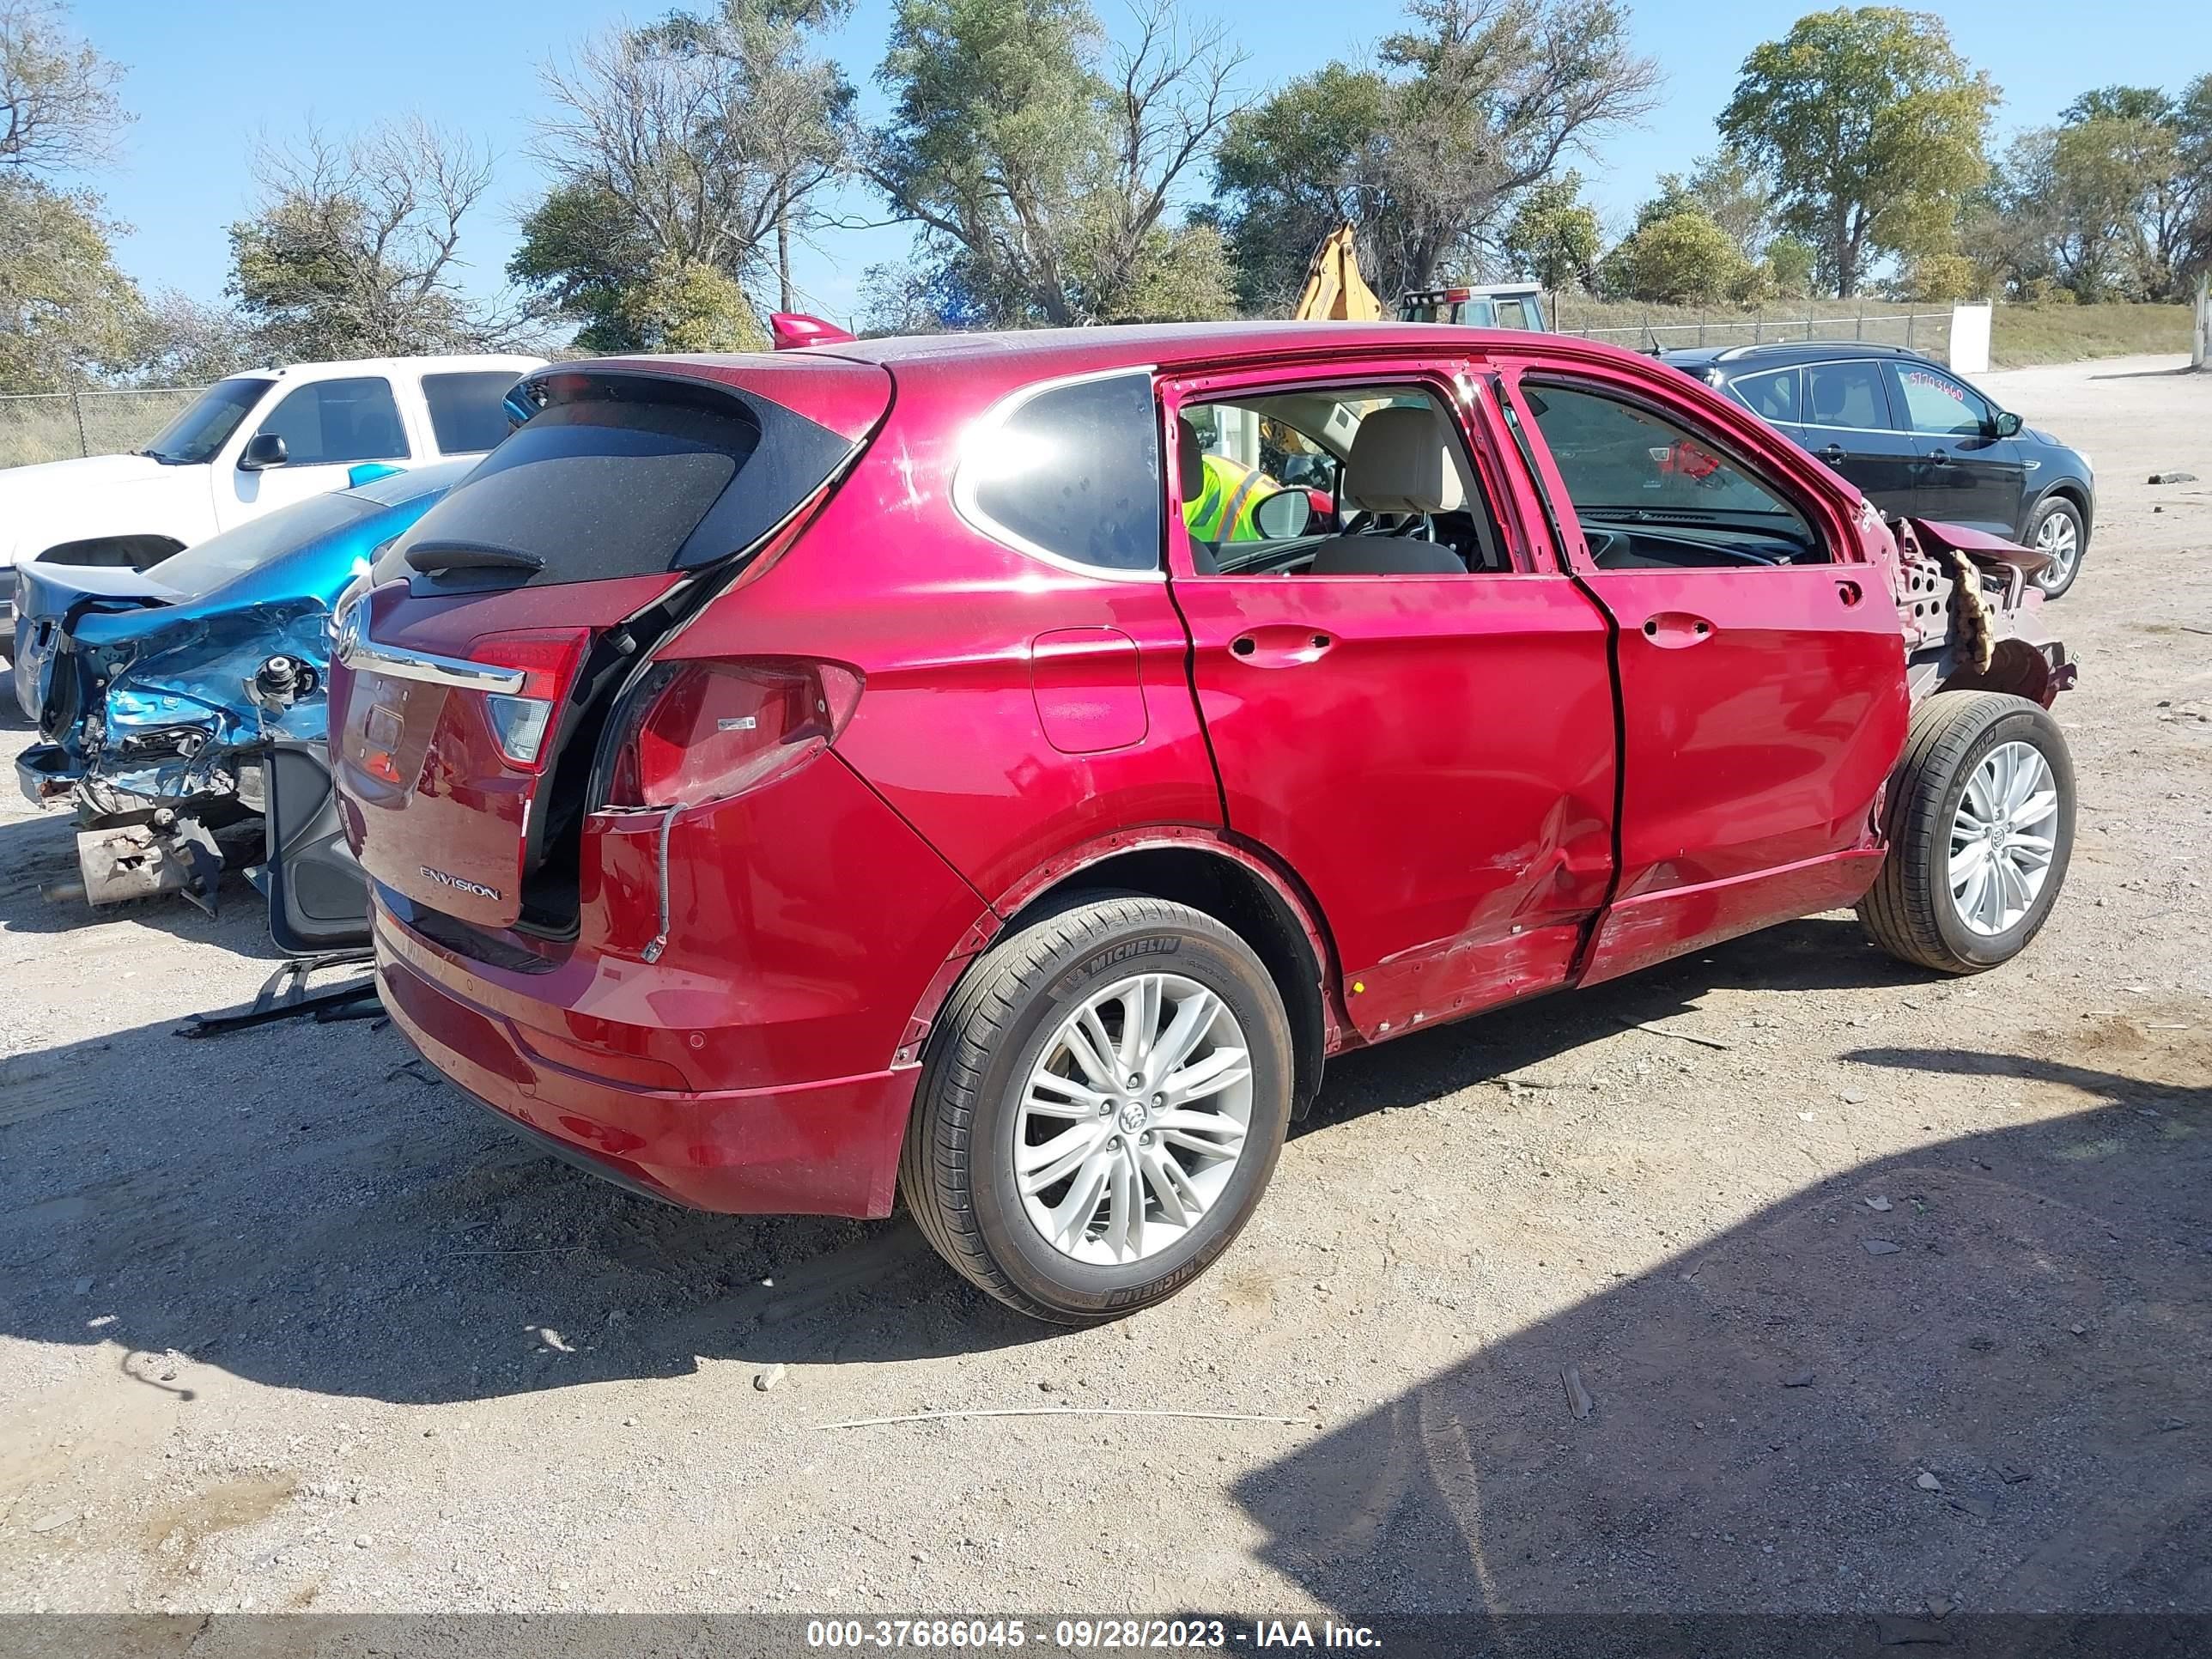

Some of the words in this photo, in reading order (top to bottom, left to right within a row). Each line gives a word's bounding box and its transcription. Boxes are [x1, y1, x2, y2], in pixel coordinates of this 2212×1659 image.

[420, 866, 501, 900] ENVISION
[1091, 938, 1180, 974] MICHELIN
[1110, 1260, 1194, 1305] MICHELIN
